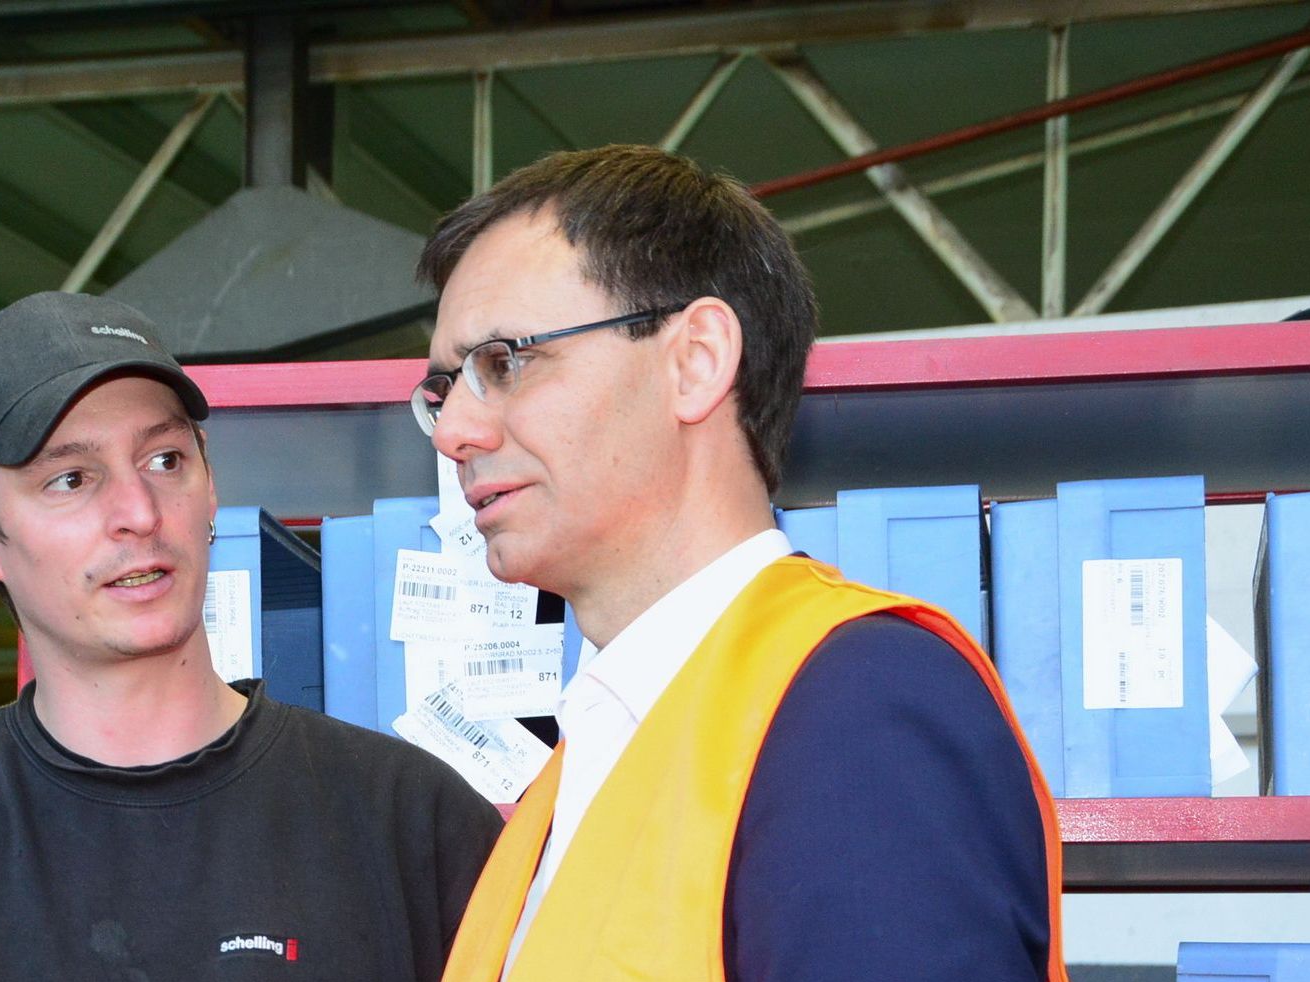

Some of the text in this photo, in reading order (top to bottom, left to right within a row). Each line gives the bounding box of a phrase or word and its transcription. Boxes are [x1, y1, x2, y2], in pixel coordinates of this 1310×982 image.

[91, 324, 149, 345] schelling
[469, 603, 490, 615] 871
[509, 609, 523, 620] 12
[538, 671, 558, 682] 871
[471, 750, 491, 769] 871
[499, 776, 514, 791] 12
[220, 935, 284, 956] schelling
